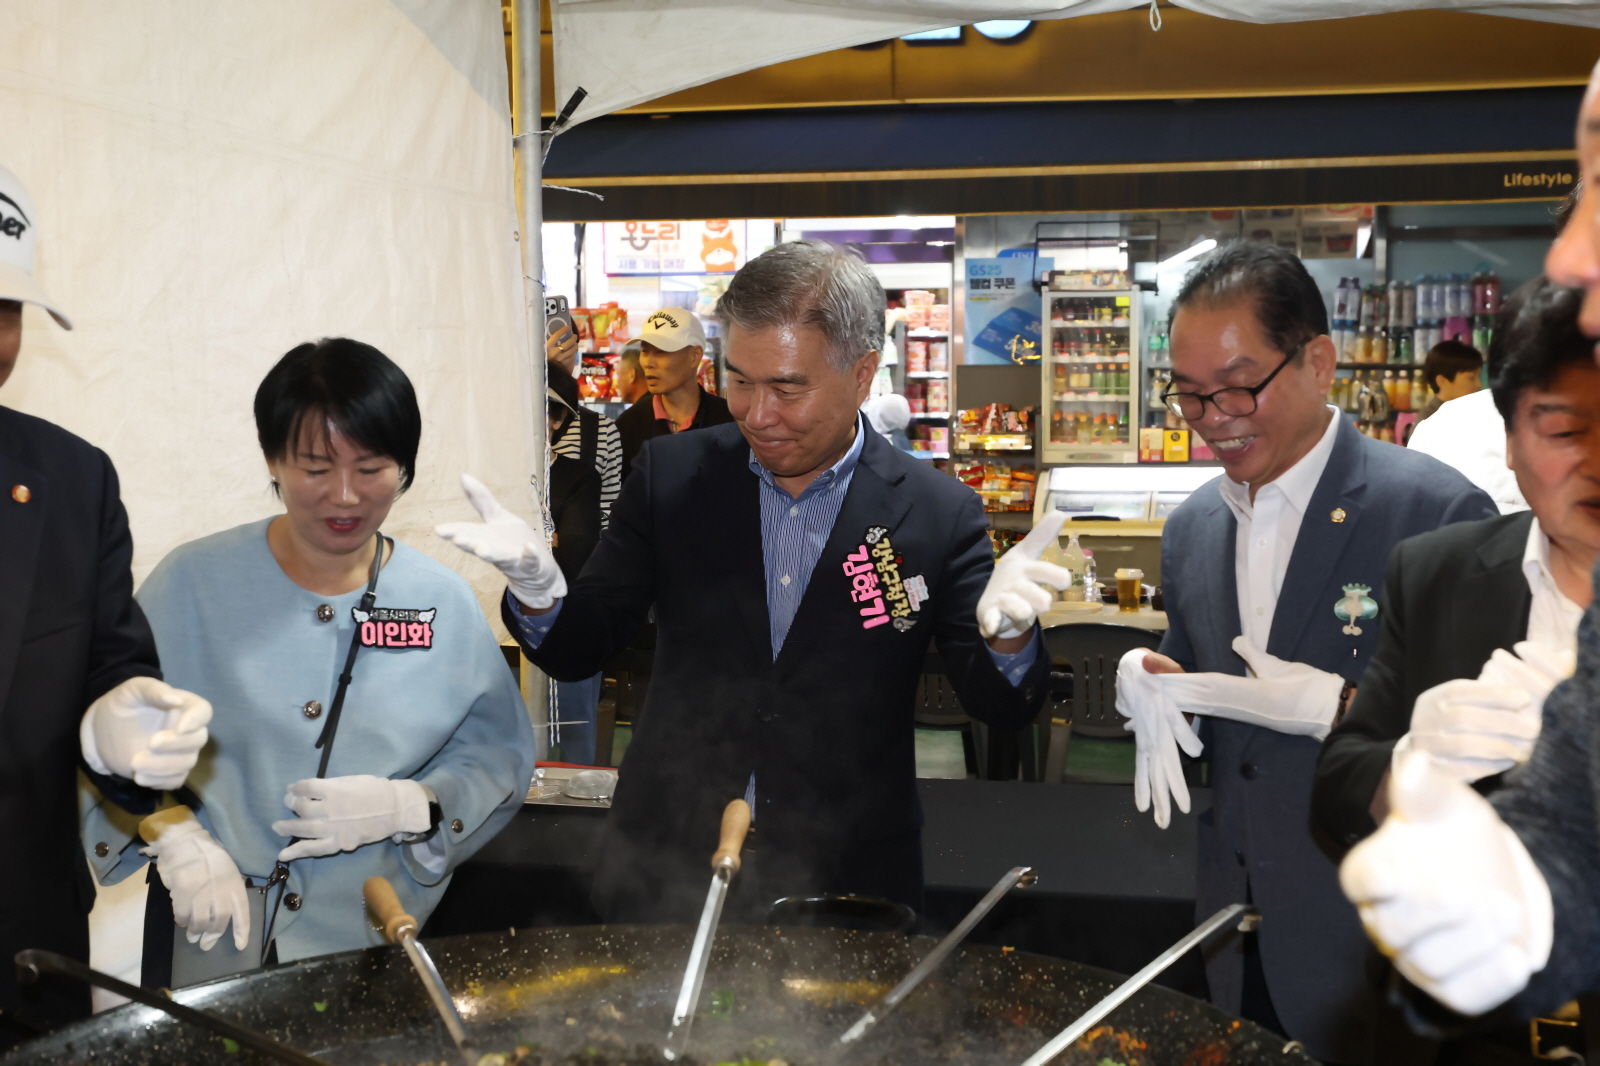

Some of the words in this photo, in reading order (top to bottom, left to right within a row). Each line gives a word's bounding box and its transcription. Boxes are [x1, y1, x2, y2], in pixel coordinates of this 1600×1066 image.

[1503, 171, 1573, 188] Lifestyle
[620, 221, 681, 251] 온누리
[969, 264, 1003, 276] GS25
[993, 277, 1016, 290] 쿠폰
[647, 311, 680, 328] Callaway
[842, 544, 891, 629] 김현기
[872, 537, 912, 618] 강남구청장
[361, 621, 433, 647] 이인화
